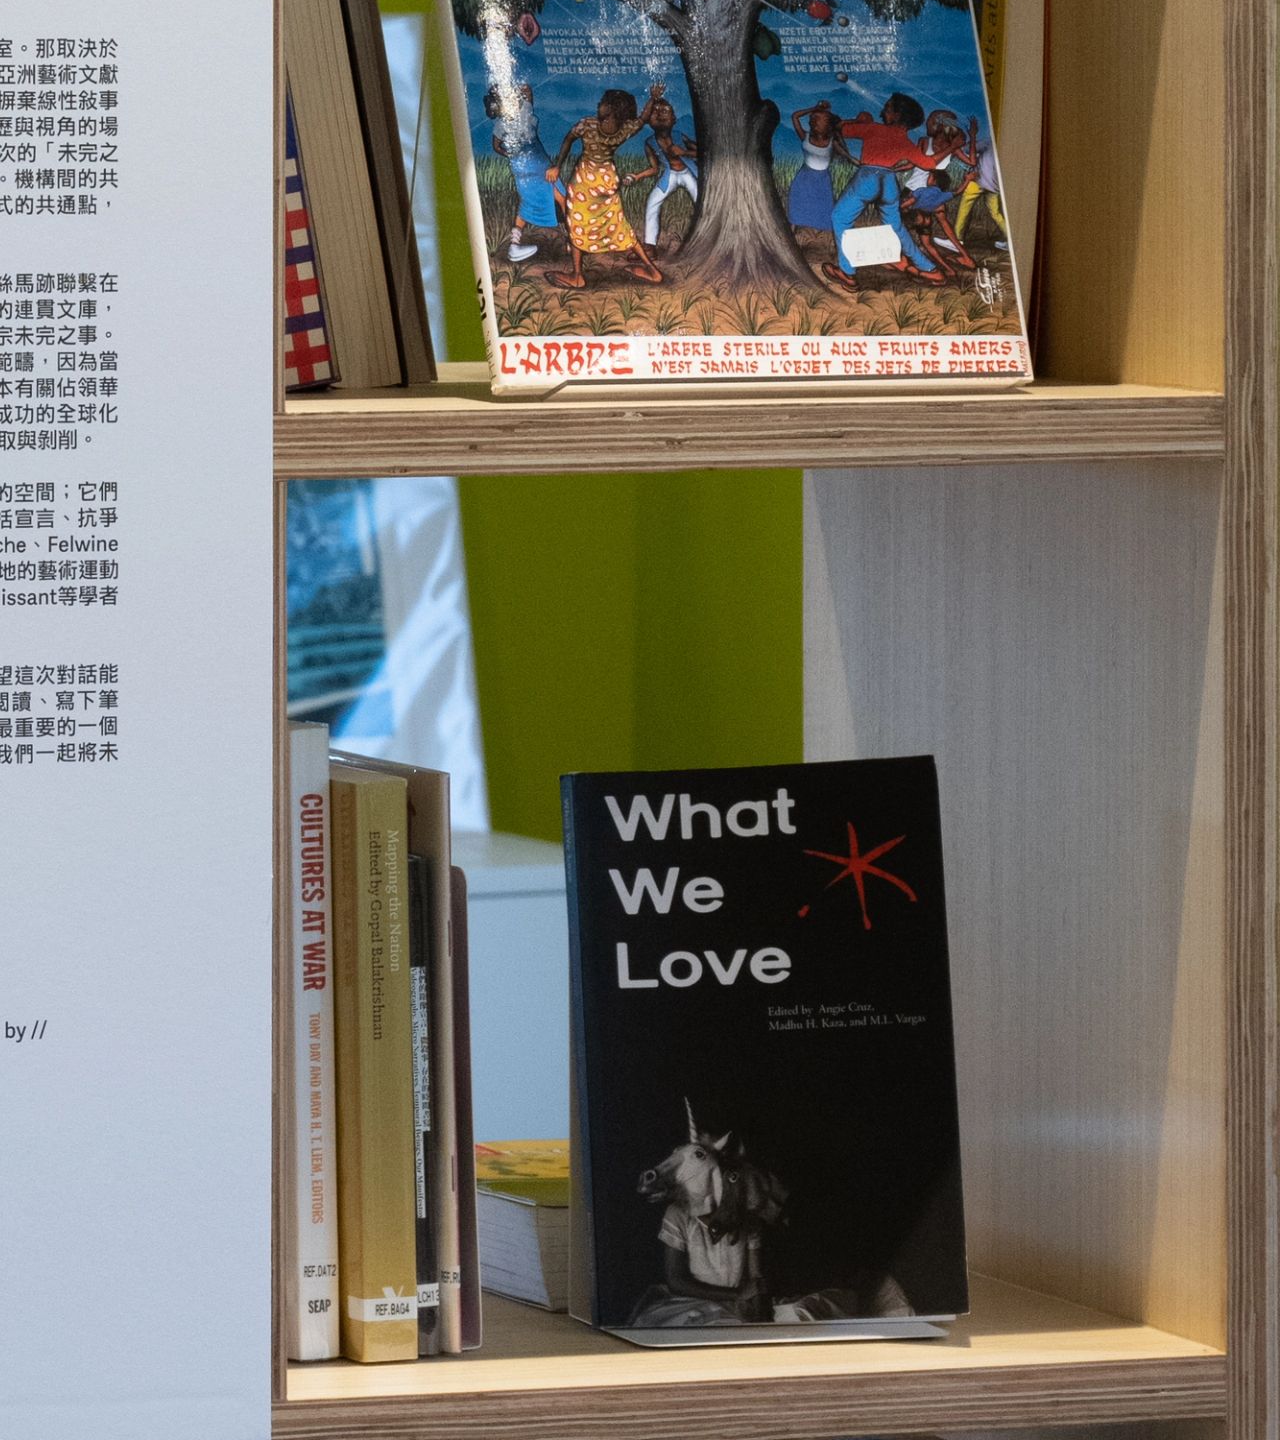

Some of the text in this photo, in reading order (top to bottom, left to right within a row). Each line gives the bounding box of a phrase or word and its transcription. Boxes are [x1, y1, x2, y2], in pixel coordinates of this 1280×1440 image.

[984, 25, 998, 88] Arts
[500, 342, 632, 374] L’ARBRE
[648, 341, 1011, 356] L’ARBRE STERILE OU AUX FRUITS AMERS
[604, 788, 796, 841] What
[300, 793, 326, 991] CULTURES AT WAR
[609, 867, 723, 914] We
[616, 942, 791, 988] Love
